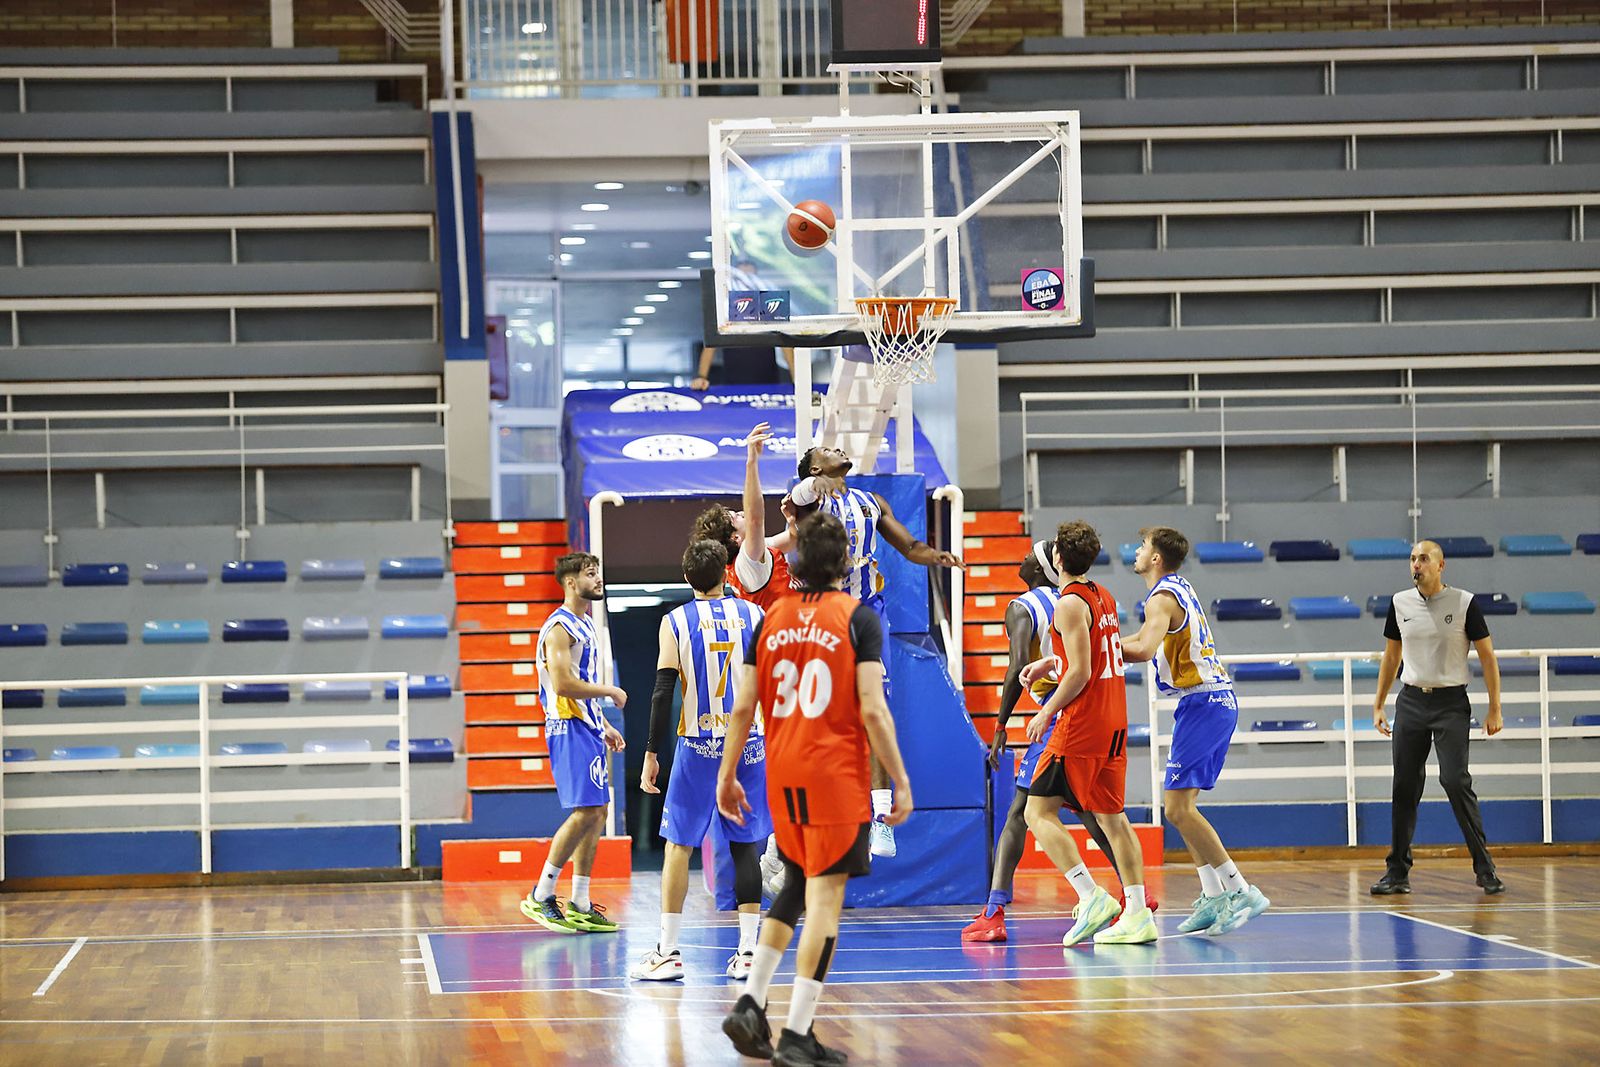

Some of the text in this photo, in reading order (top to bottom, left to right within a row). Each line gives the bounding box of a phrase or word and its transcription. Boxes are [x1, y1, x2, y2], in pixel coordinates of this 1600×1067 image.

[1031, 279, 1049, 290] EBA
[1031, 288, 1056, 300] FINAL
[766, 623, 842, 652] GONZÁLEZ
[1099, 632, 1125, 679] 18
[708, 641, 735, 698] 7
[771, 658, 833, 719] 30
